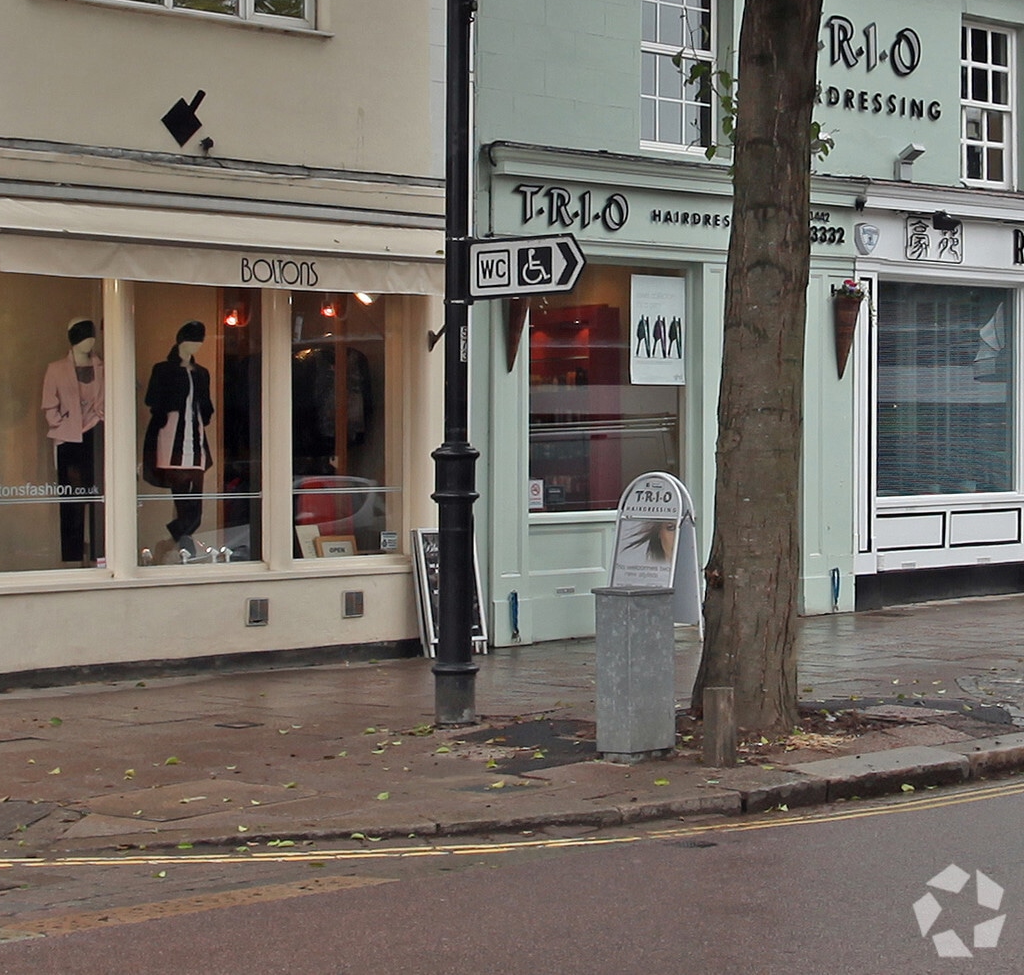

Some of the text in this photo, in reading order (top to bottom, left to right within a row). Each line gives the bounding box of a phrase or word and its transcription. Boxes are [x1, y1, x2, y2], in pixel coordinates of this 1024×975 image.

[651, 209, 730, 228] HAIRDRES
[809, 211, 830, 223] 1442
[241, 257, 318, 286] BOLTONS
[481, 259, 506, 279] WC
